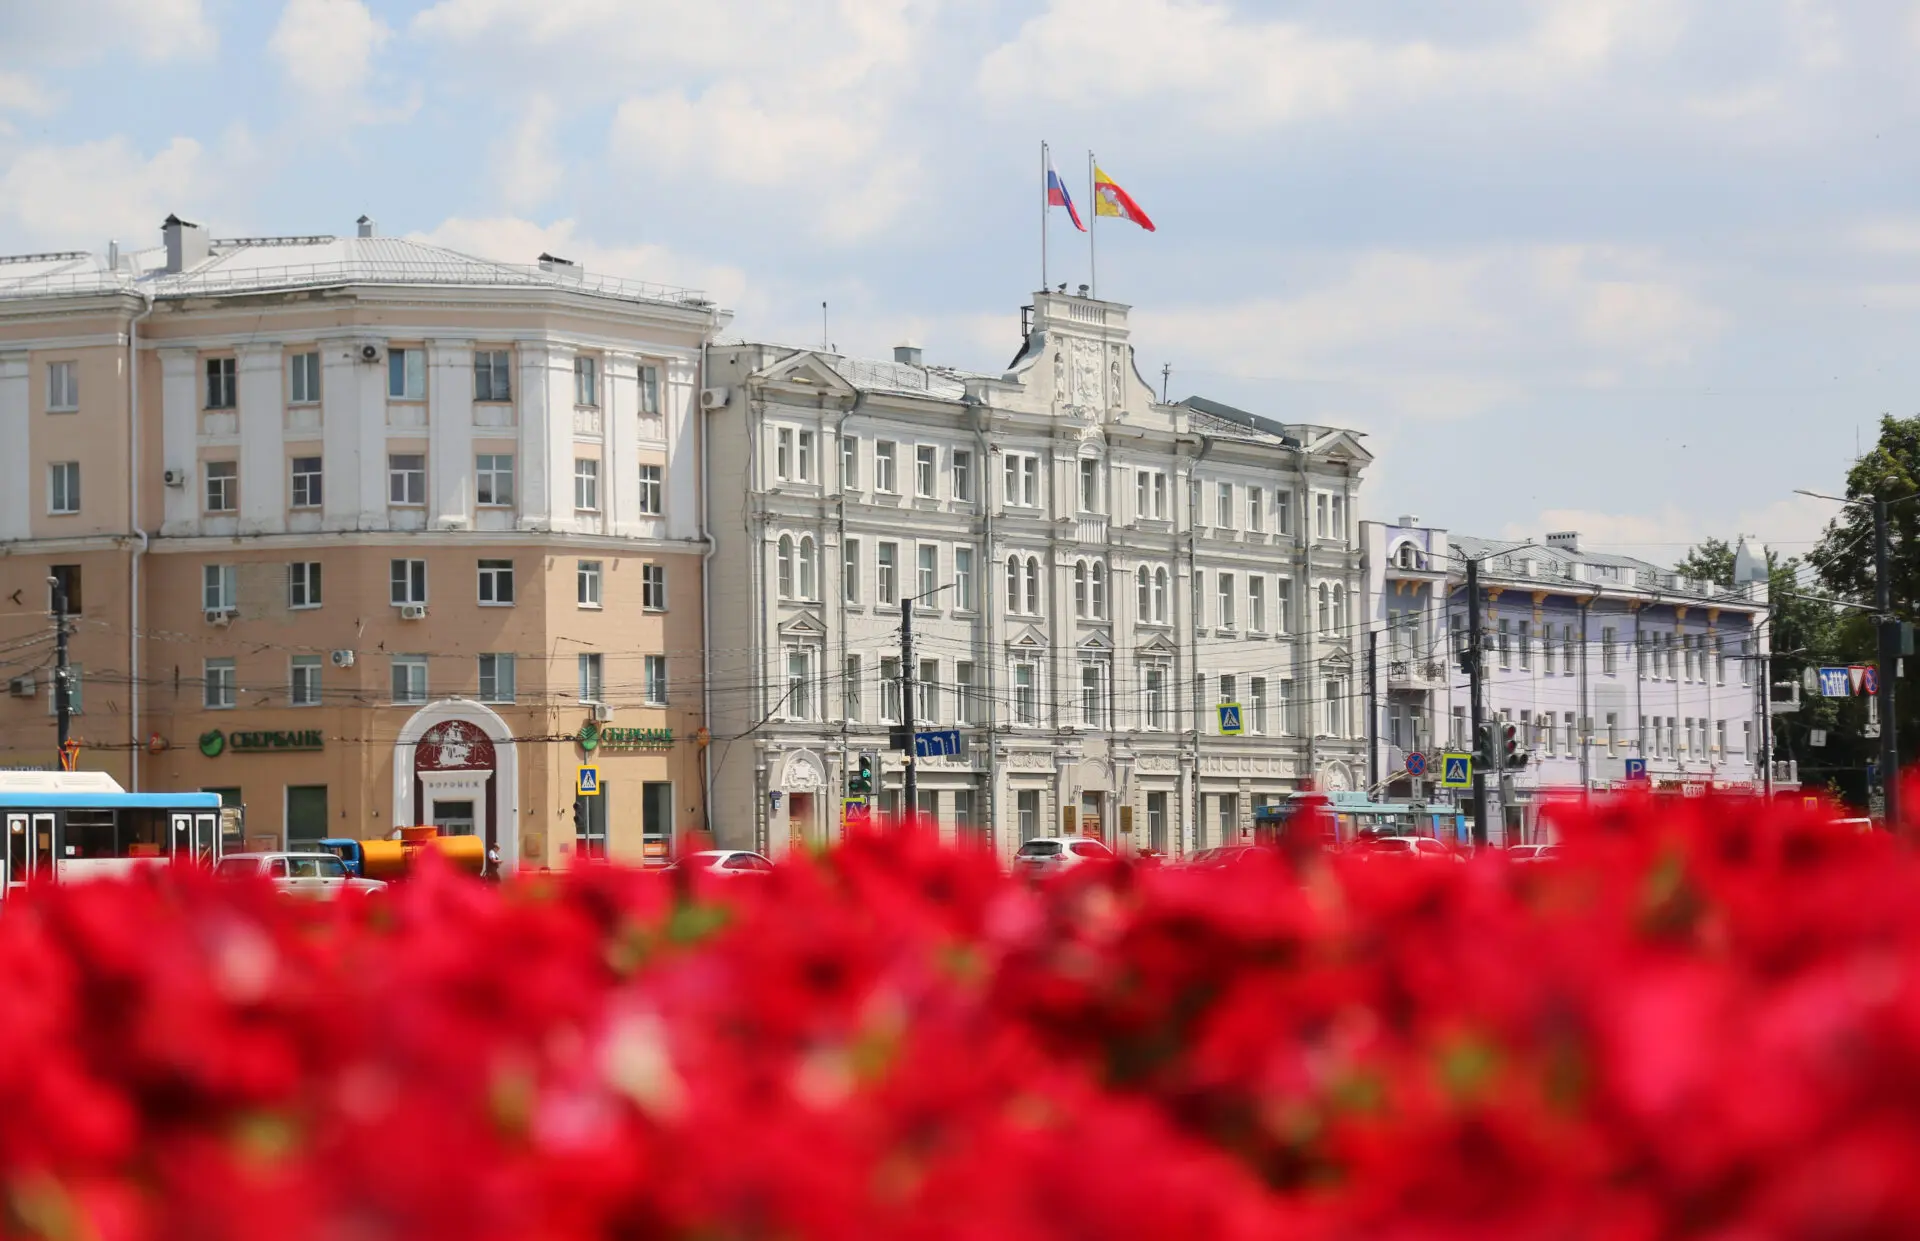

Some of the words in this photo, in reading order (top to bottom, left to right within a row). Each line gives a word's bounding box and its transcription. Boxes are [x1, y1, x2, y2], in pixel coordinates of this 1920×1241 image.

[230, 730, 323, 748] СБЕРБАНК
[602, 727, 673, 743] СБЕРБАНК
[1631, 761, 1643, 778] P
[428, 780, 480, 788] ВОРОНЕЖ
